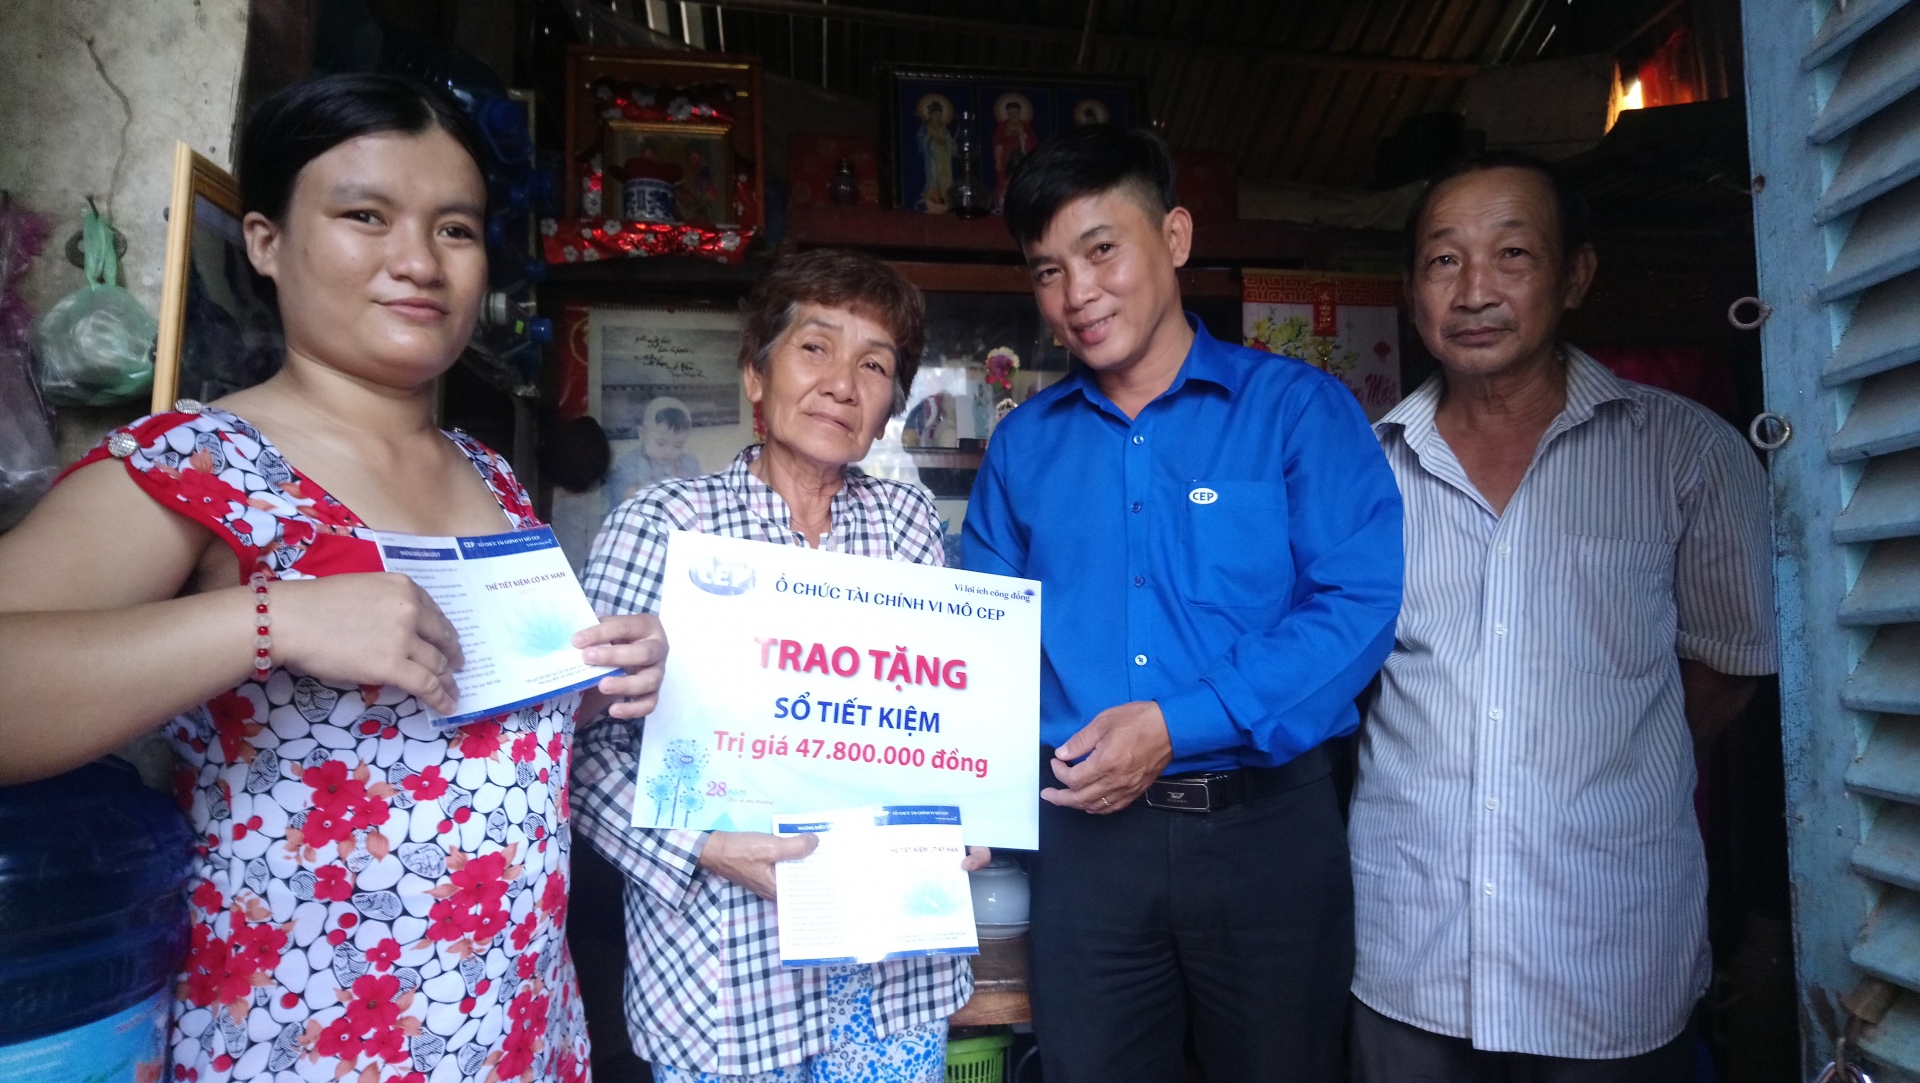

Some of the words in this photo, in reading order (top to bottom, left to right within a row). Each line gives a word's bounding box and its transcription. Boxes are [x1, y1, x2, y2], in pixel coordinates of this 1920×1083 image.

[1192, 492, 1214, 501] CEP
[793, 582, 841, 600] CHỨC
[845, 586, 869, 603] TÀI
[874, 592, 924, 611] CHÍNH
[928, 600, 943, 613] VI
[947, 602, 972, 617] MÔ
[976, 606, 1005, 621] CEP
[754, 636, 860, 678] TRAO
[868, 644, 968, 692] TẶNG
[774, 691, 811, 721] SỔ
[817, 697, 872, 726] TIẾT
[878, 705, 940, 737] KIỆM
[713, 730, 745, 758] Trị
[751, 734, 789, 760] giá
[795, 738, 925, 768] 47.800.000
[931, 747, 988, 778] đồng
[705, 780, 727, 797] 28
